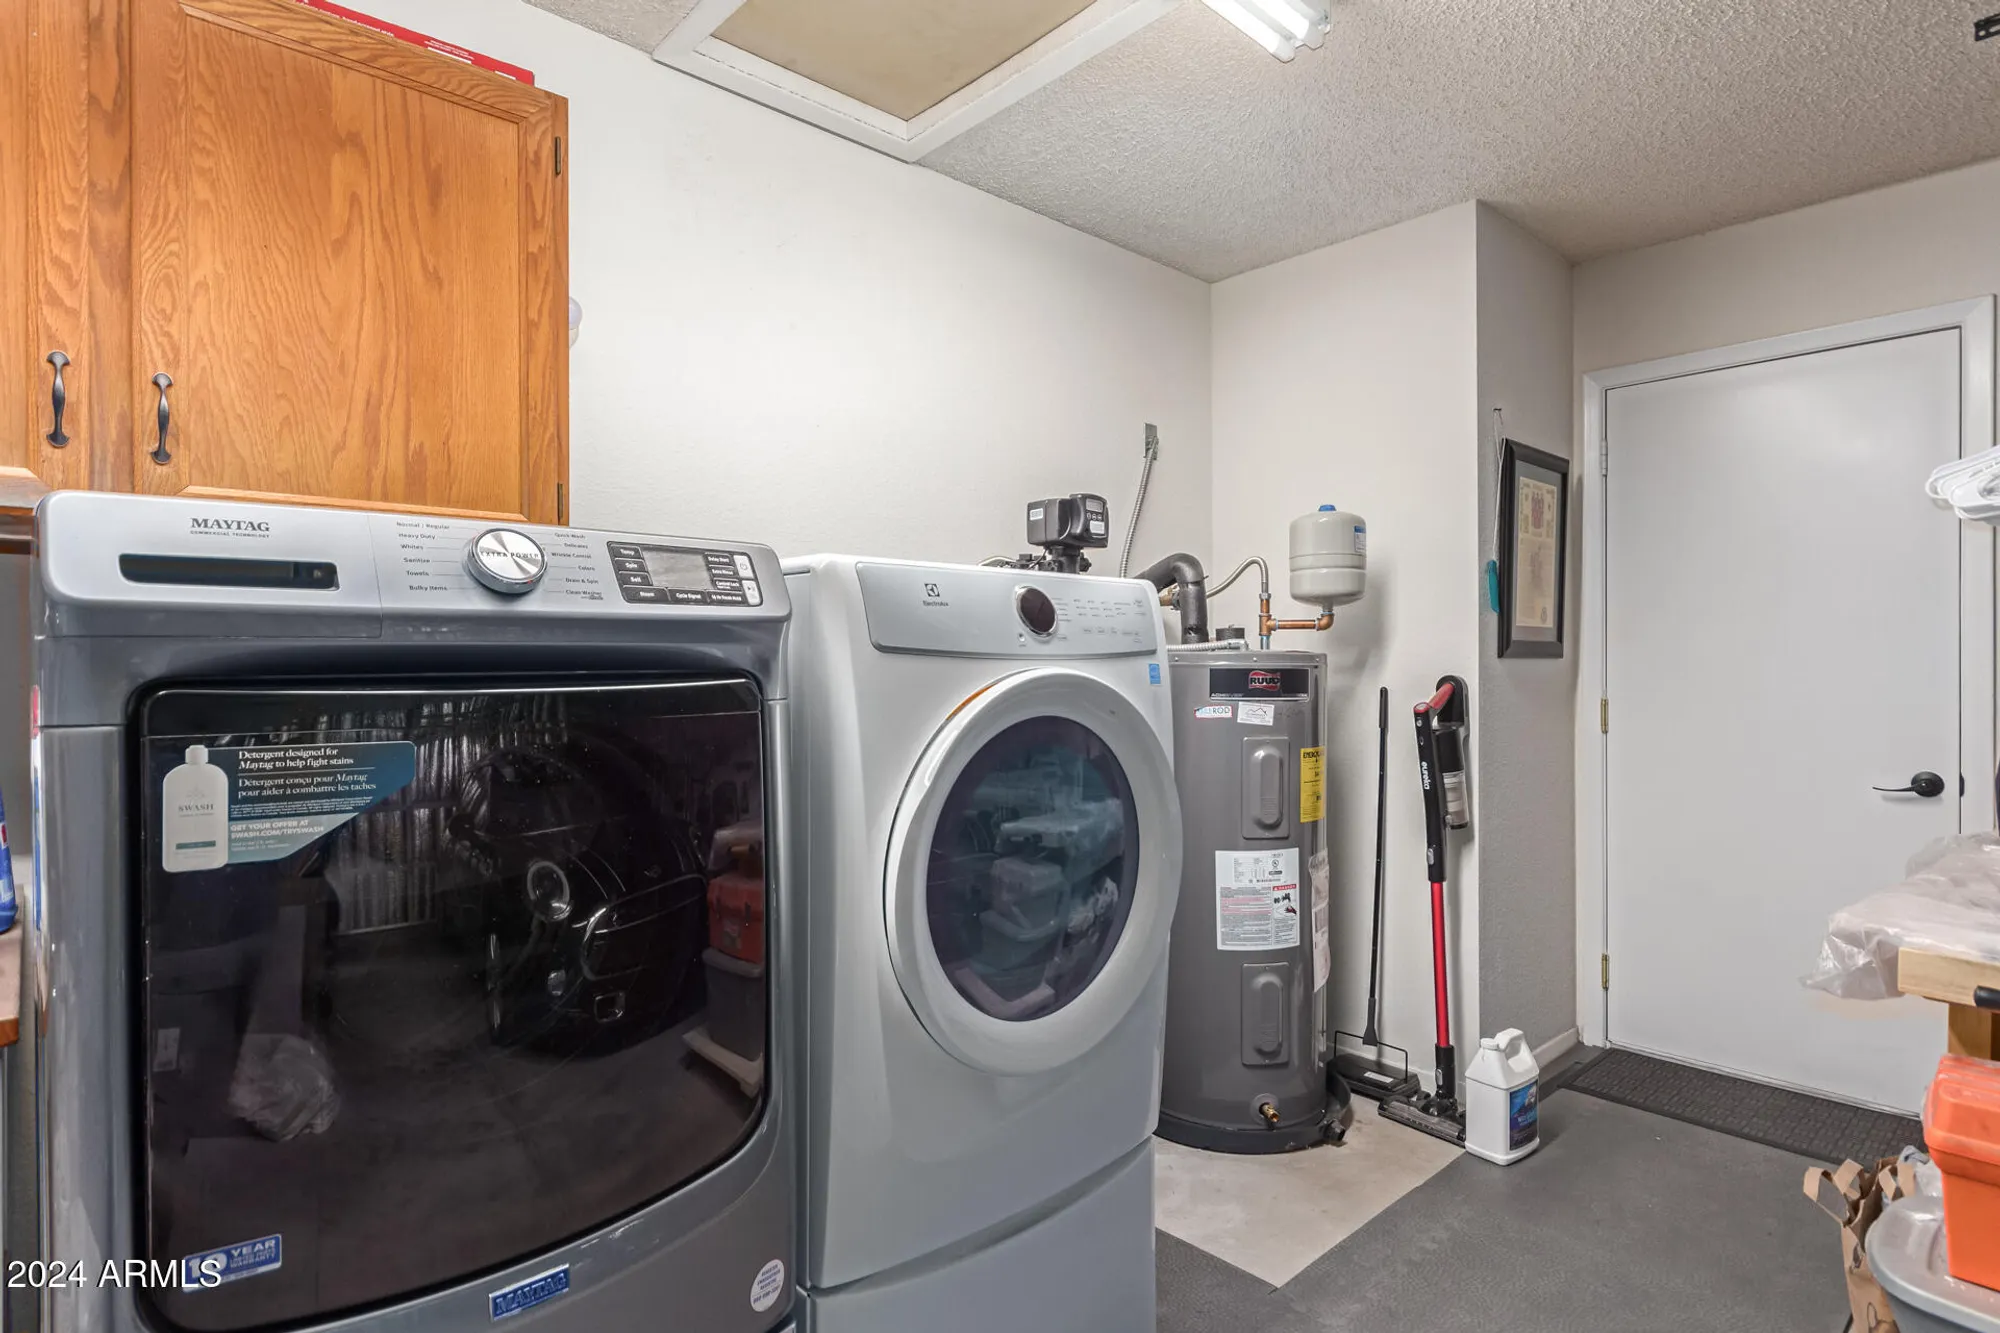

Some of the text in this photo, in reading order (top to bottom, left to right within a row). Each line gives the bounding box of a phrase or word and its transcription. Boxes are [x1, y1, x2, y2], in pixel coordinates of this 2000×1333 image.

[191, 517, 270, 531] MAYTAG
[1250, 677, 1280, 685] RUUD
[238, 747, 339, 760] Detergent designed for
[238, 757, 354, 770] Maytag to help fight stains
[285, 776, 312, 787] conçu
[312, 775, 334, 784] pour
[335, 772, 368, 783] Maytag
[1420, 761, 1431, 790] eureka
[238, 790, 260, 799] pour
[261, 787, 284, 796] aider
[292, 784, 337, 794] combattre
[338, 783, 350, 791] les
[350, 782, 377, 791] taches
[178, 804, 214, 812] SWASH
[230, 823, 248, 832] GET
[248, 822, 272, 830] YOUR
[272, 820, 298, 829] OFFER
[230, 826, 324, 840] SWASH.COM/TRYSWASH
[230, 1238, 276, 1257] YEAR
[495, 1272, 566, 1315] MAYTAG
